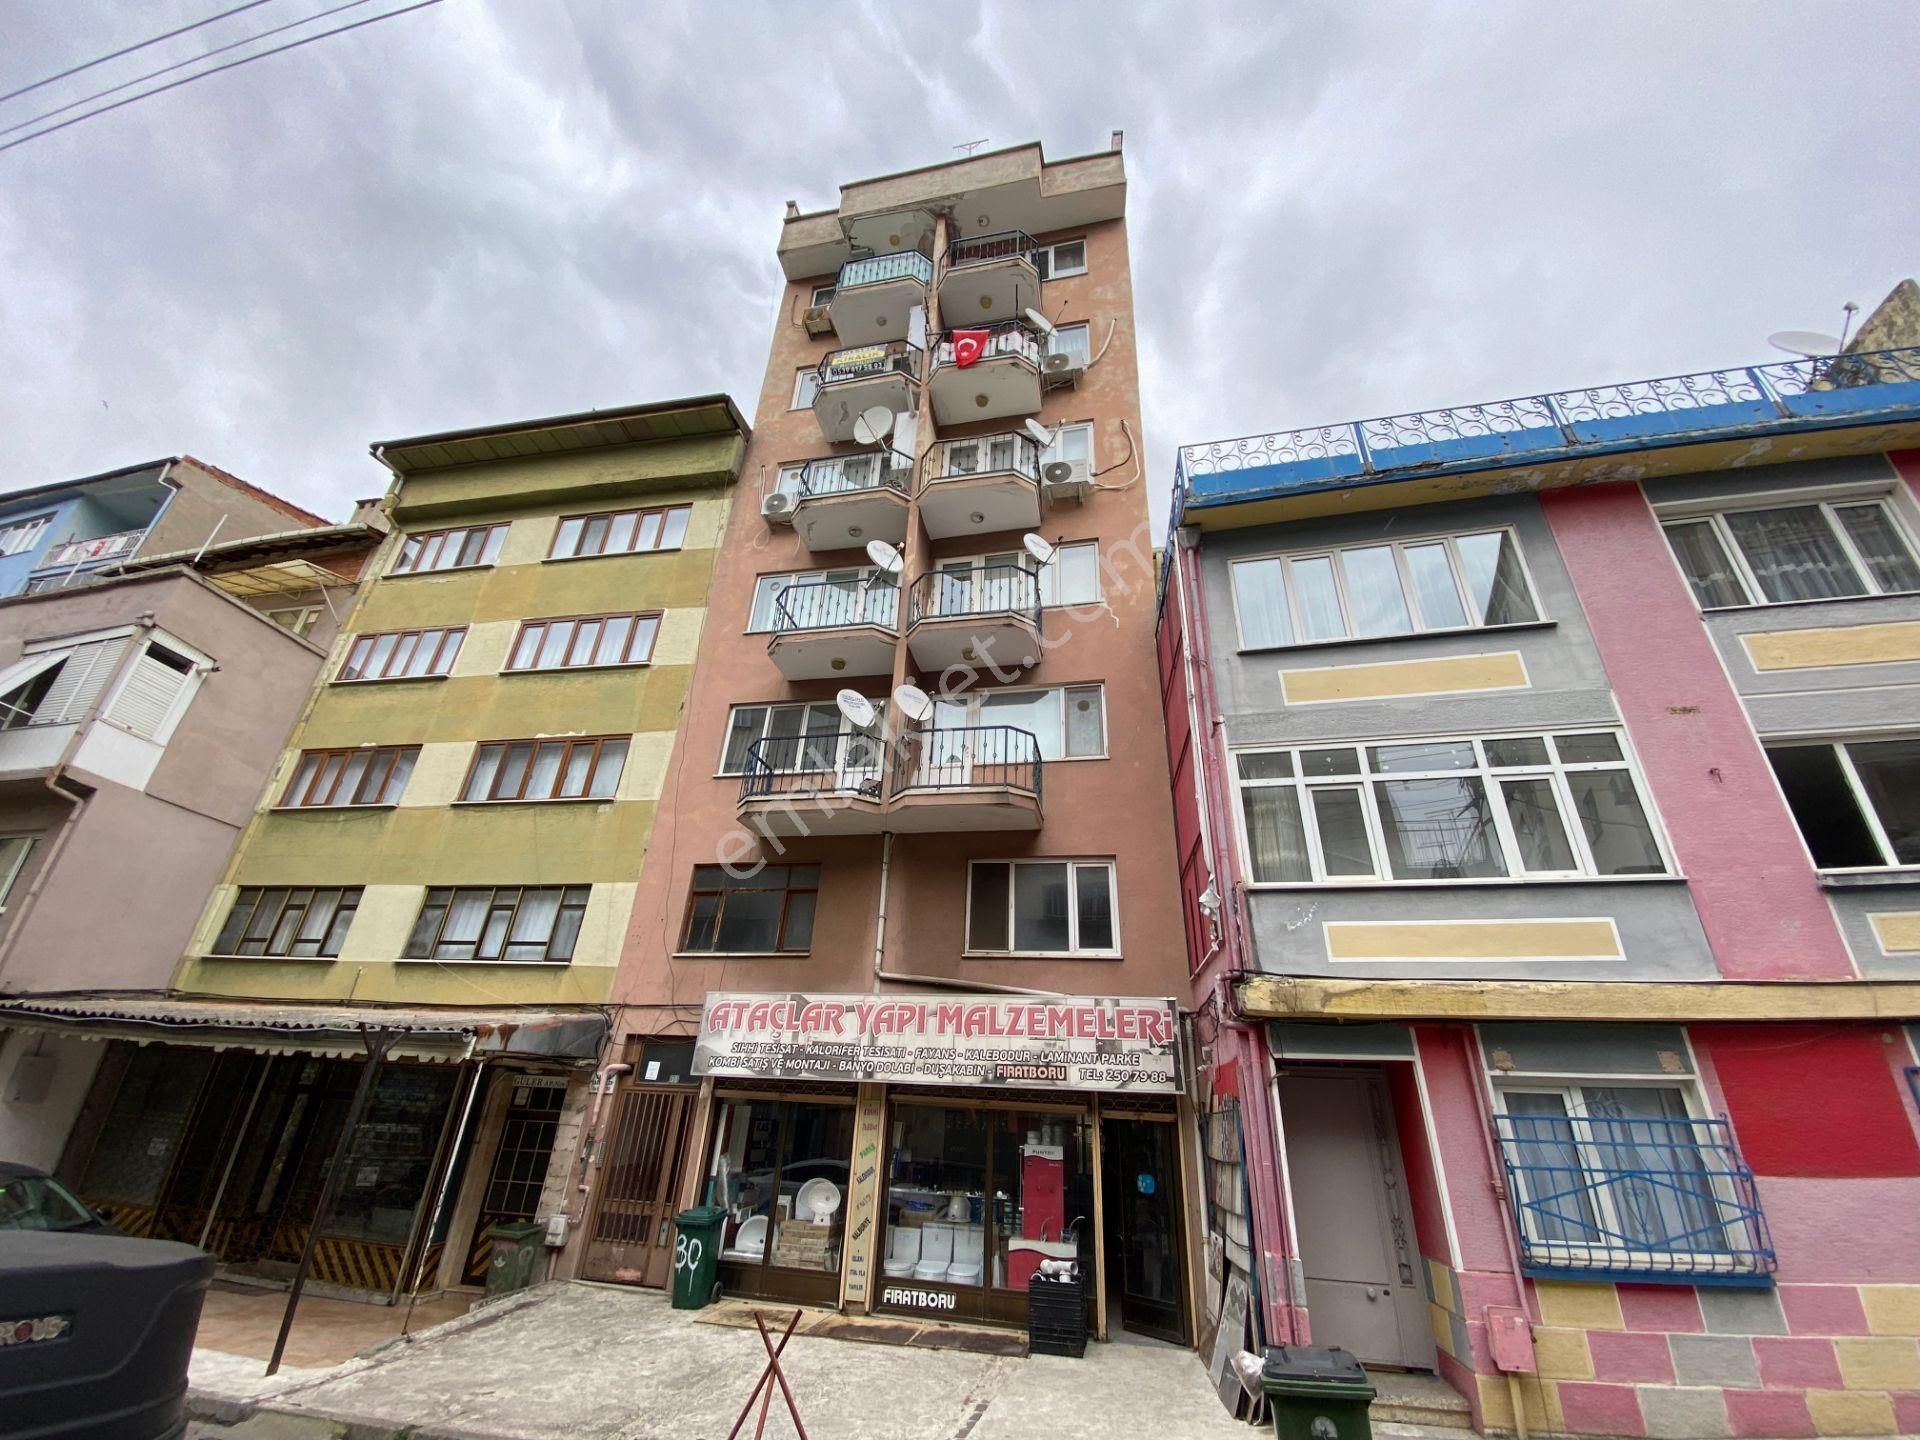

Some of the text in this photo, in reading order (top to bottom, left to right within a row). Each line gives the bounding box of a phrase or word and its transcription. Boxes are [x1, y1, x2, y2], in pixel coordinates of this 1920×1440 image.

[708, 1001, 1175, 1045] ATAÇLAR YAPI MALZEMELERİ
[759, 1043, 799, 1055] TESİSAT
[862, 1046, 906, 1058] TESİSATI
[914, 1048, 956, 1061] FAYANS
[965, 1049, 1031, 1062] KALEBODUR
[1040, 1051, 1099, 1064] LAMİNANT
[1101, 1053, 1140, 1066] PARKE
[708, 1057, 741, 1068] KOMBİ
[741, 1057, 769, 1071] SATIŞ
[770, 1058, 784, 1070] VE
[785, 1058, 830, 1071] MONTAJI
[839, 1060, 874, 1073] BANYO
[876, 1062, 915, 1074] DOLABI
[923, 1062, 985, 1078] DUŞAKABİN
[996, 1064, 1066, 1080] FIRATBORU
[1079, 1069, 1103, 1081] TEL:
[1105, 1070, 1129, 1082] 250
[1132, 1071, 1148, 1082] 79
[1150, 1071, 1167, 1083] 88
[883, 1288, 956, 1310] FIRATBORU
